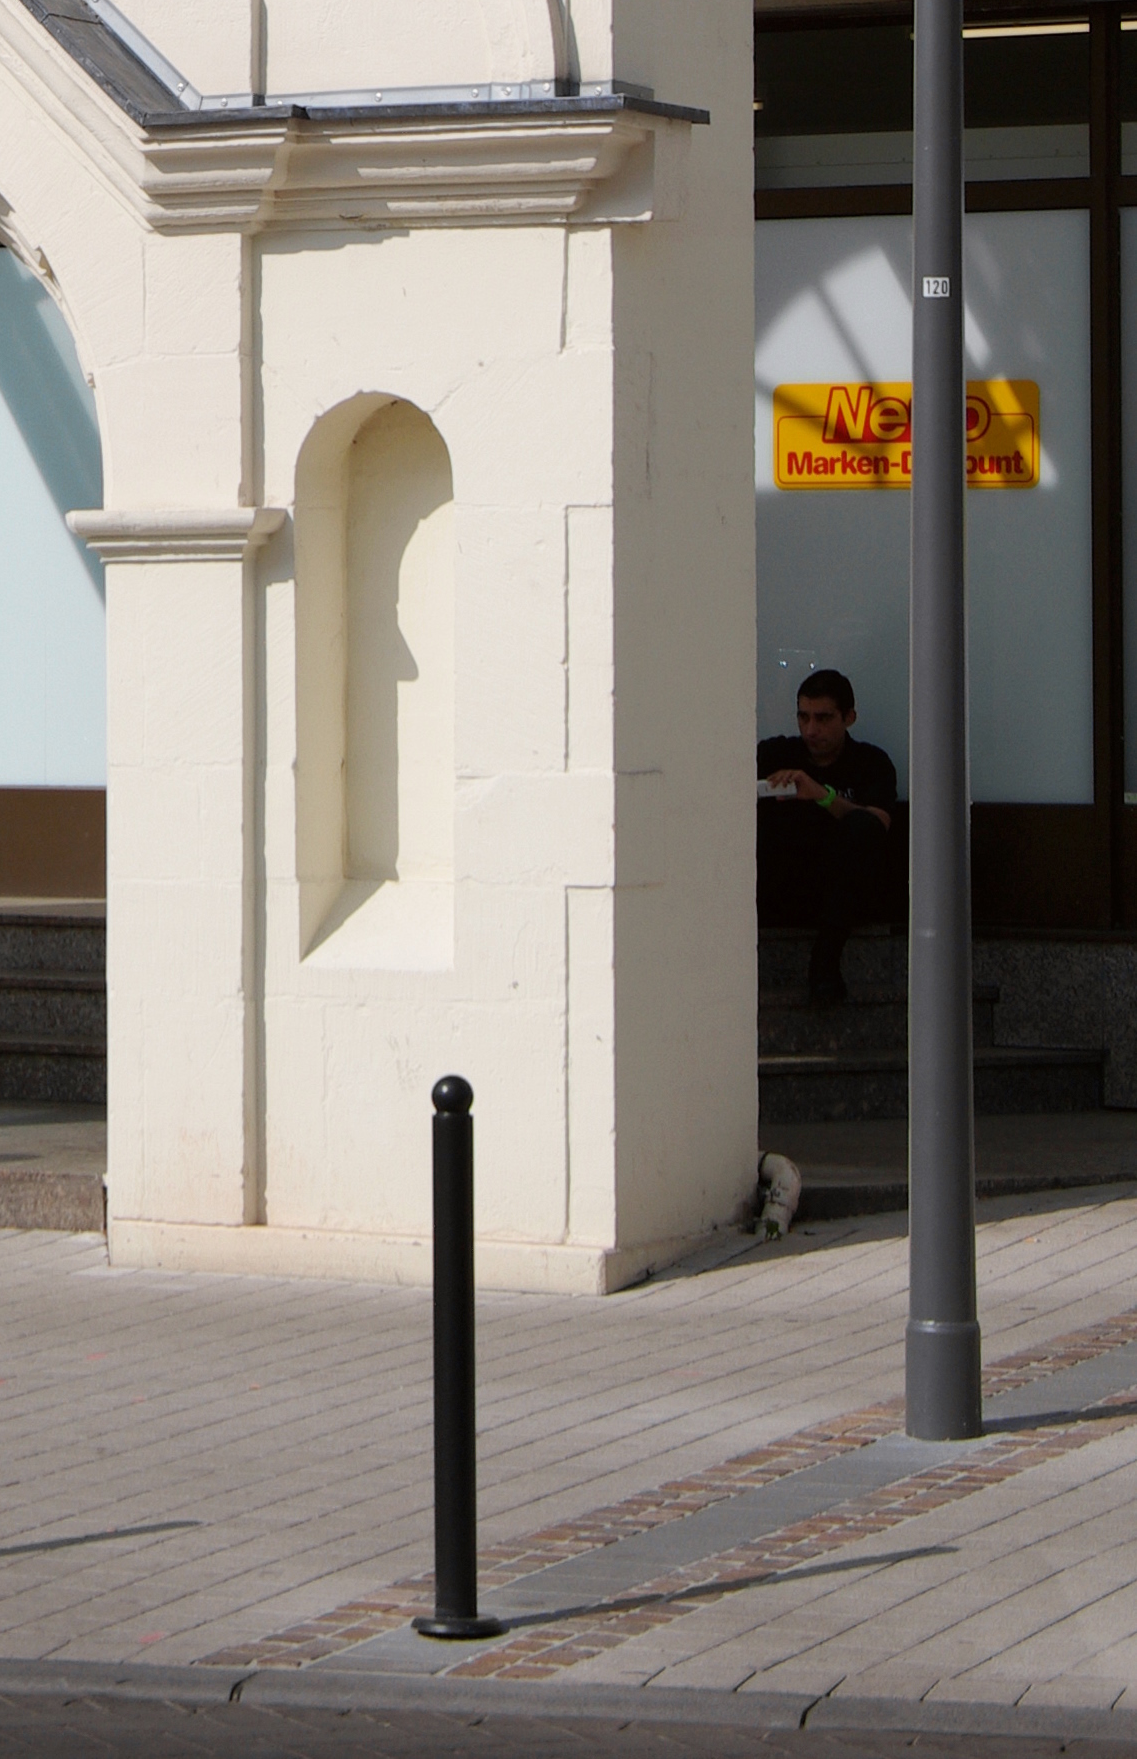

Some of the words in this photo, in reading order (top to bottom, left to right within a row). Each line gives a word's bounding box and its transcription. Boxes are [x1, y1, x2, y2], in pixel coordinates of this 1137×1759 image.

[926, 279, 948, 295] 120
[822, 386, 991, 444] Neo
[787, 450, 1024, 476] Marken-ount
